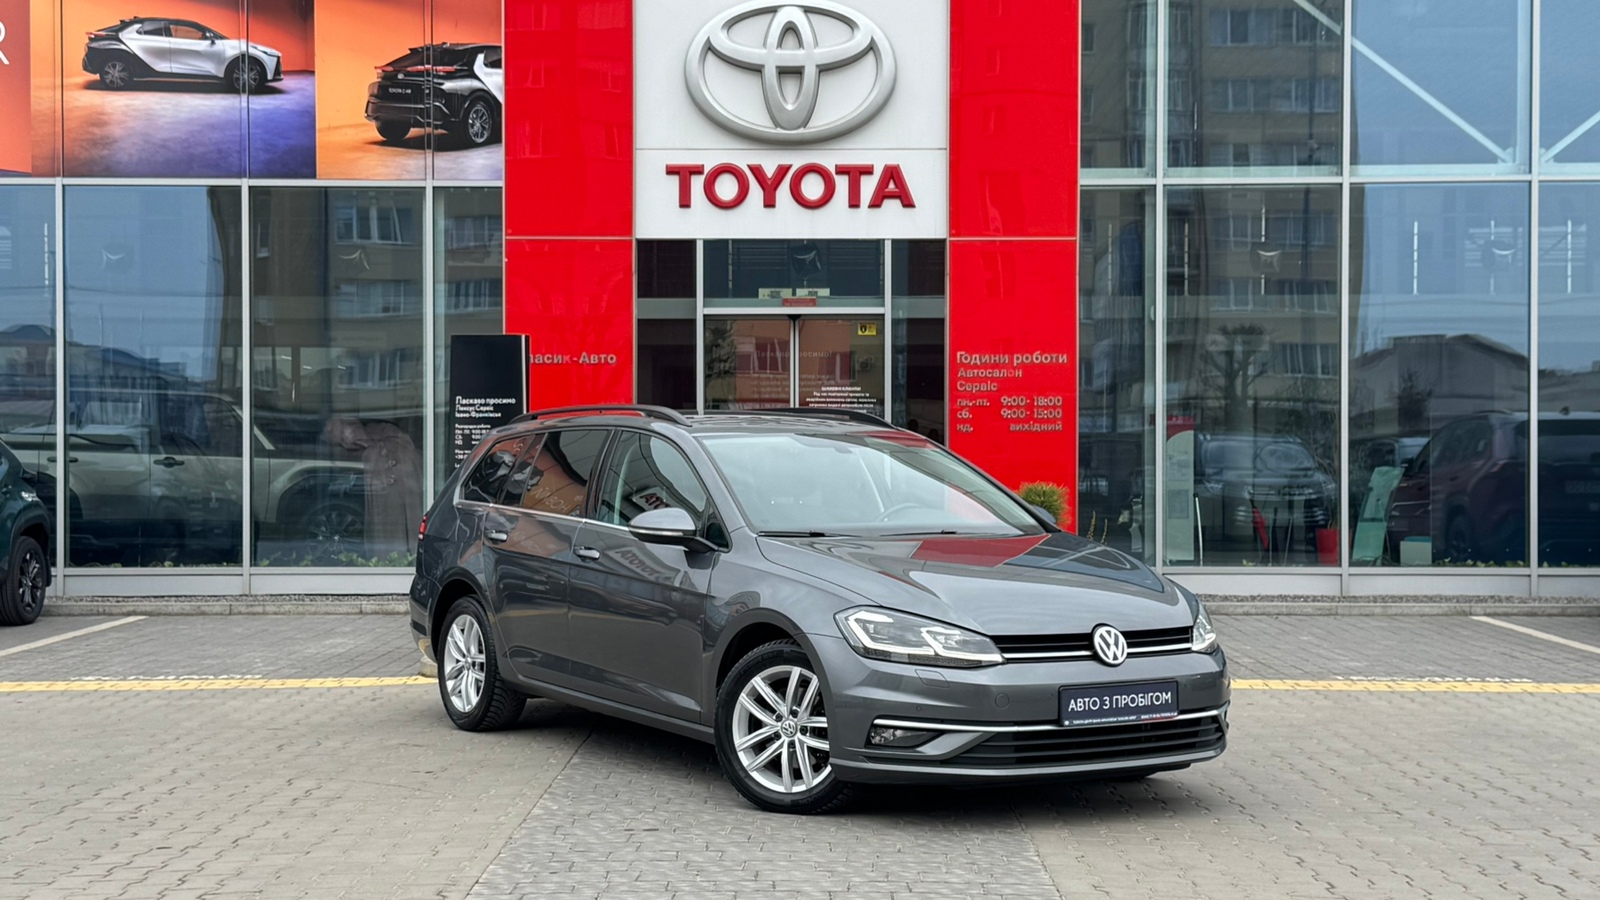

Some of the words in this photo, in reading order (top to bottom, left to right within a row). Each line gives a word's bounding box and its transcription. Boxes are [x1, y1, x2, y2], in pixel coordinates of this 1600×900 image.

[665, 163, 916, 210] TOYOTA
[956, 351, 1009, 366] Години
[1013, 350, 1068, 367] роботи
[957, 367, 1023, 378] Автосалон
[956, 380, 998, 393] Сервіс
[455, 395, 485, 405] Ласкаво
[486, 398, 516, 406] просимо
[1033, 395, 1063, 407] 18:00
[956, 408, 973, 419] сб.
[1033, 407, 1063, 419] 15:00
[1009, 420, 1063, 433] вихідний
[1067, 696, 1101, 712] АВТО
[1102, 696, 1111, 710] З
[1112, 691, 1172, 709] ПРОБІГОМ
